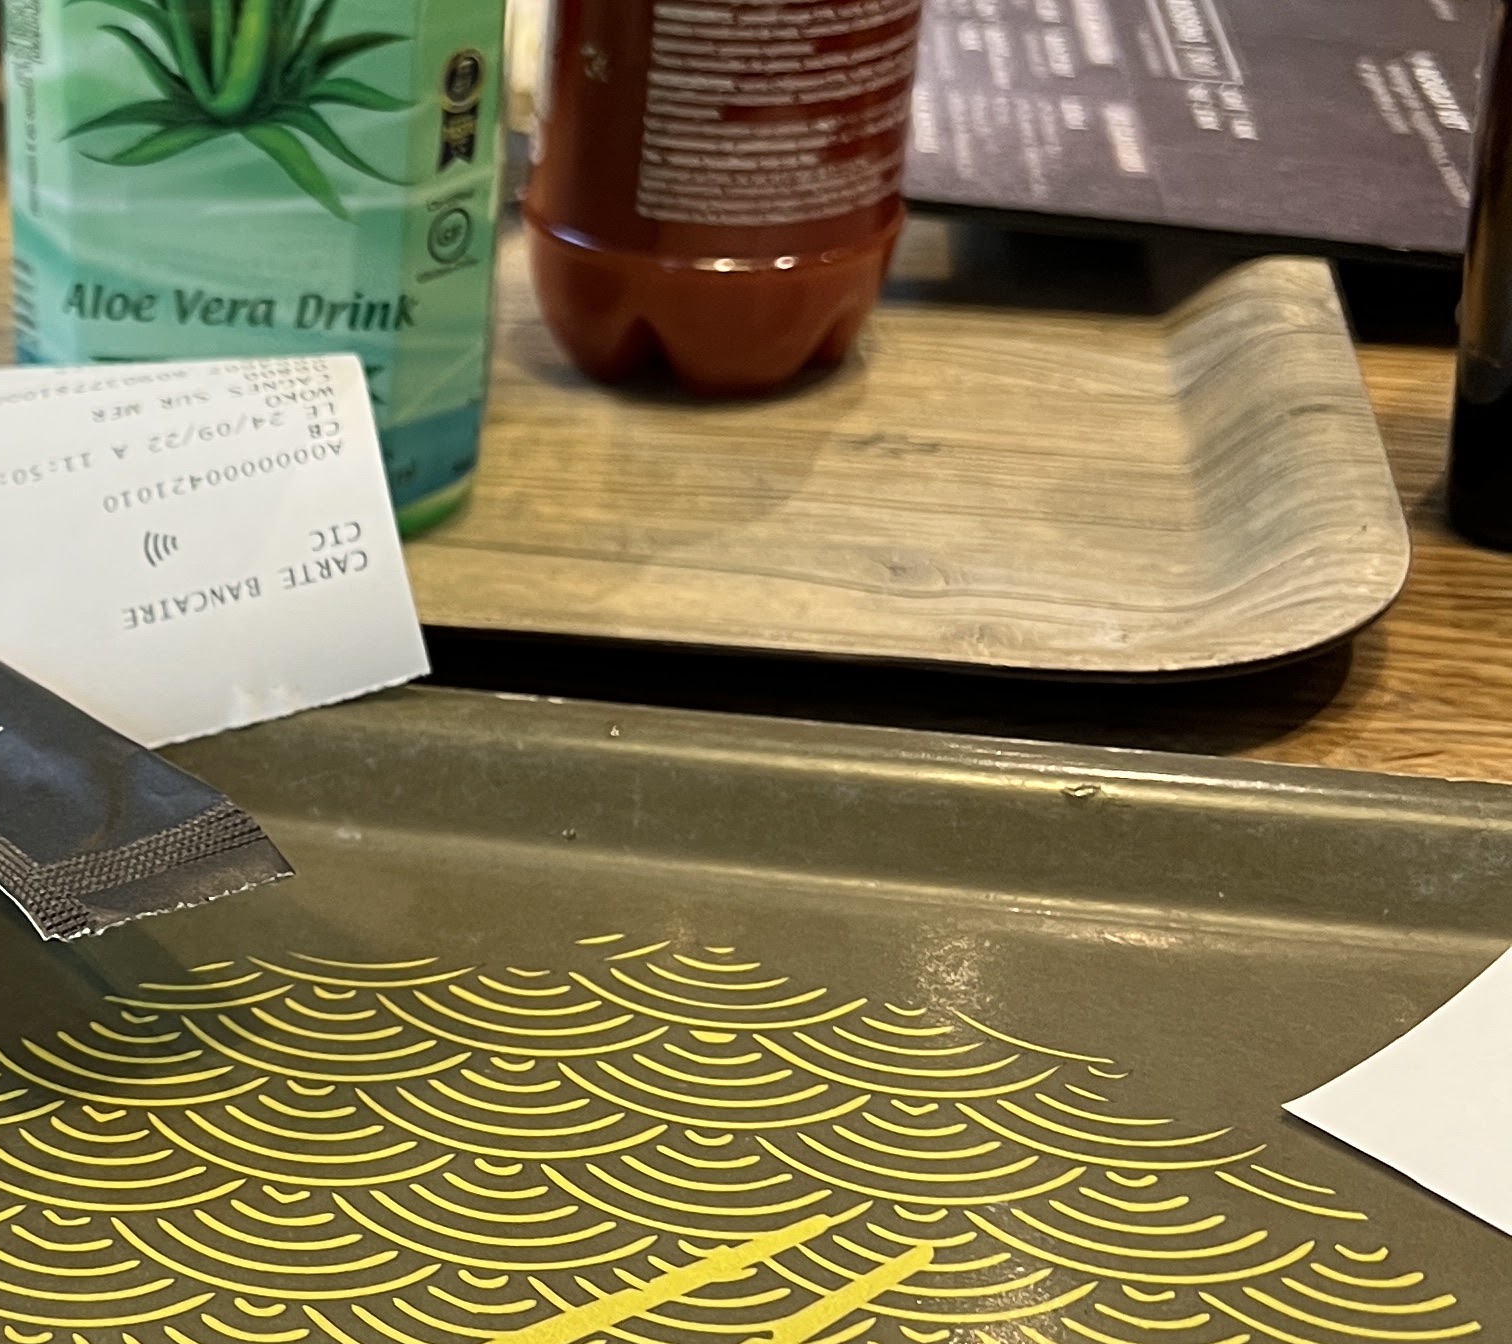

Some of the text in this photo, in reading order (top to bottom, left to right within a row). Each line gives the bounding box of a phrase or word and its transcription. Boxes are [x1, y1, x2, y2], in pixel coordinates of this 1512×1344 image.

[62, 282, 419, 332] Aloe Vera Drink
[91, 403, 143, 423] MER
[160, 391, 211, 410] SUR
[308, 402, 335, 420] LE
[148, 412, 287, 454] 24/09/22
[308, 420, 340, 439] CB
[310, 521, 362, 553] CIC
[122, 550, 368, 630] CARTE BANCAIRE
